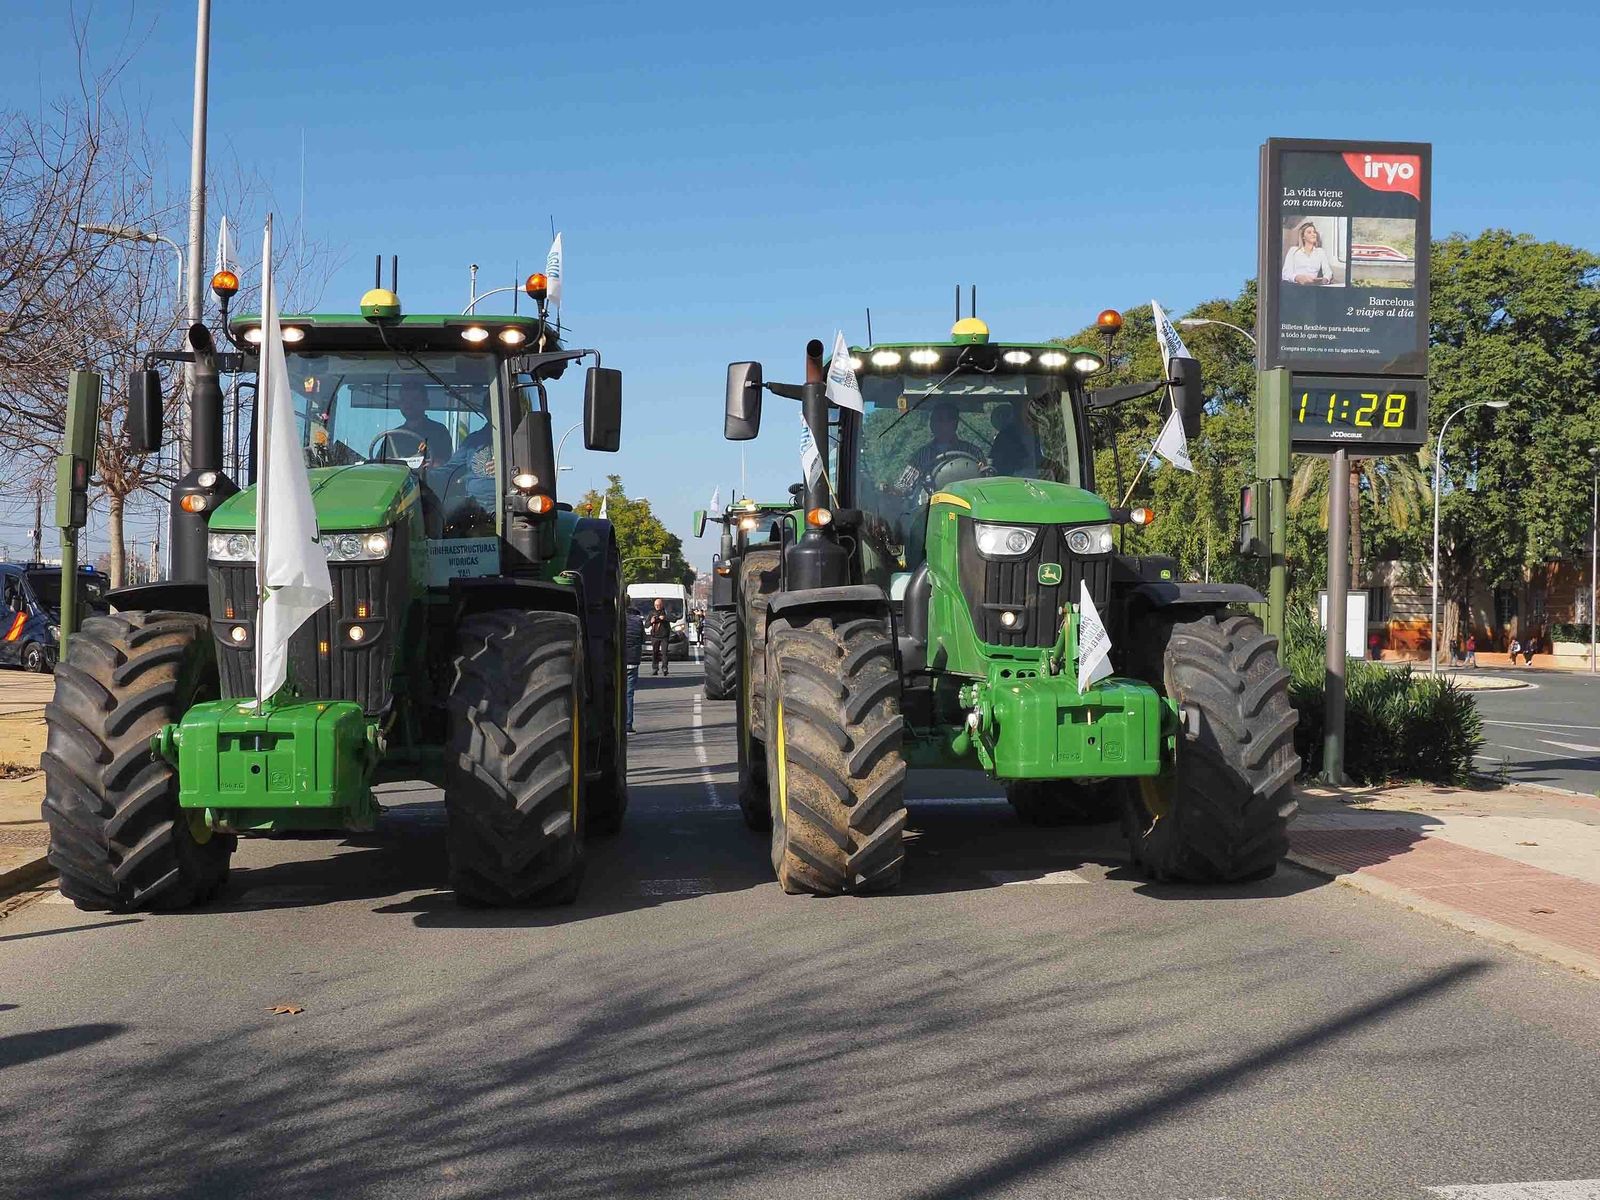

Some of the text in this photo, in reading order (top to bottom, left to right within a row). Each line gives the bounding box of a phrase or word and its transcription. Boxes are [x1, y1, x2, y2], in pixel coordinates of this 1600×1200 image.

[1364, 156, 1414, 184] iryo
[1283, 187, 1343, 199] La vida viene
[1282, 198, 1345, 208] con cambios.
[1369, 297, 1414, 306] Barcelona
[1346, 307, 1414, 318] 2 viajes al día
[1281, 323, 1303, 331] Billetes
[1303, 324, 1328, 332] flexibles
[1342, 326, 1370, 334] adaptarte
[1298, 392, 1407, 428] 11:28
